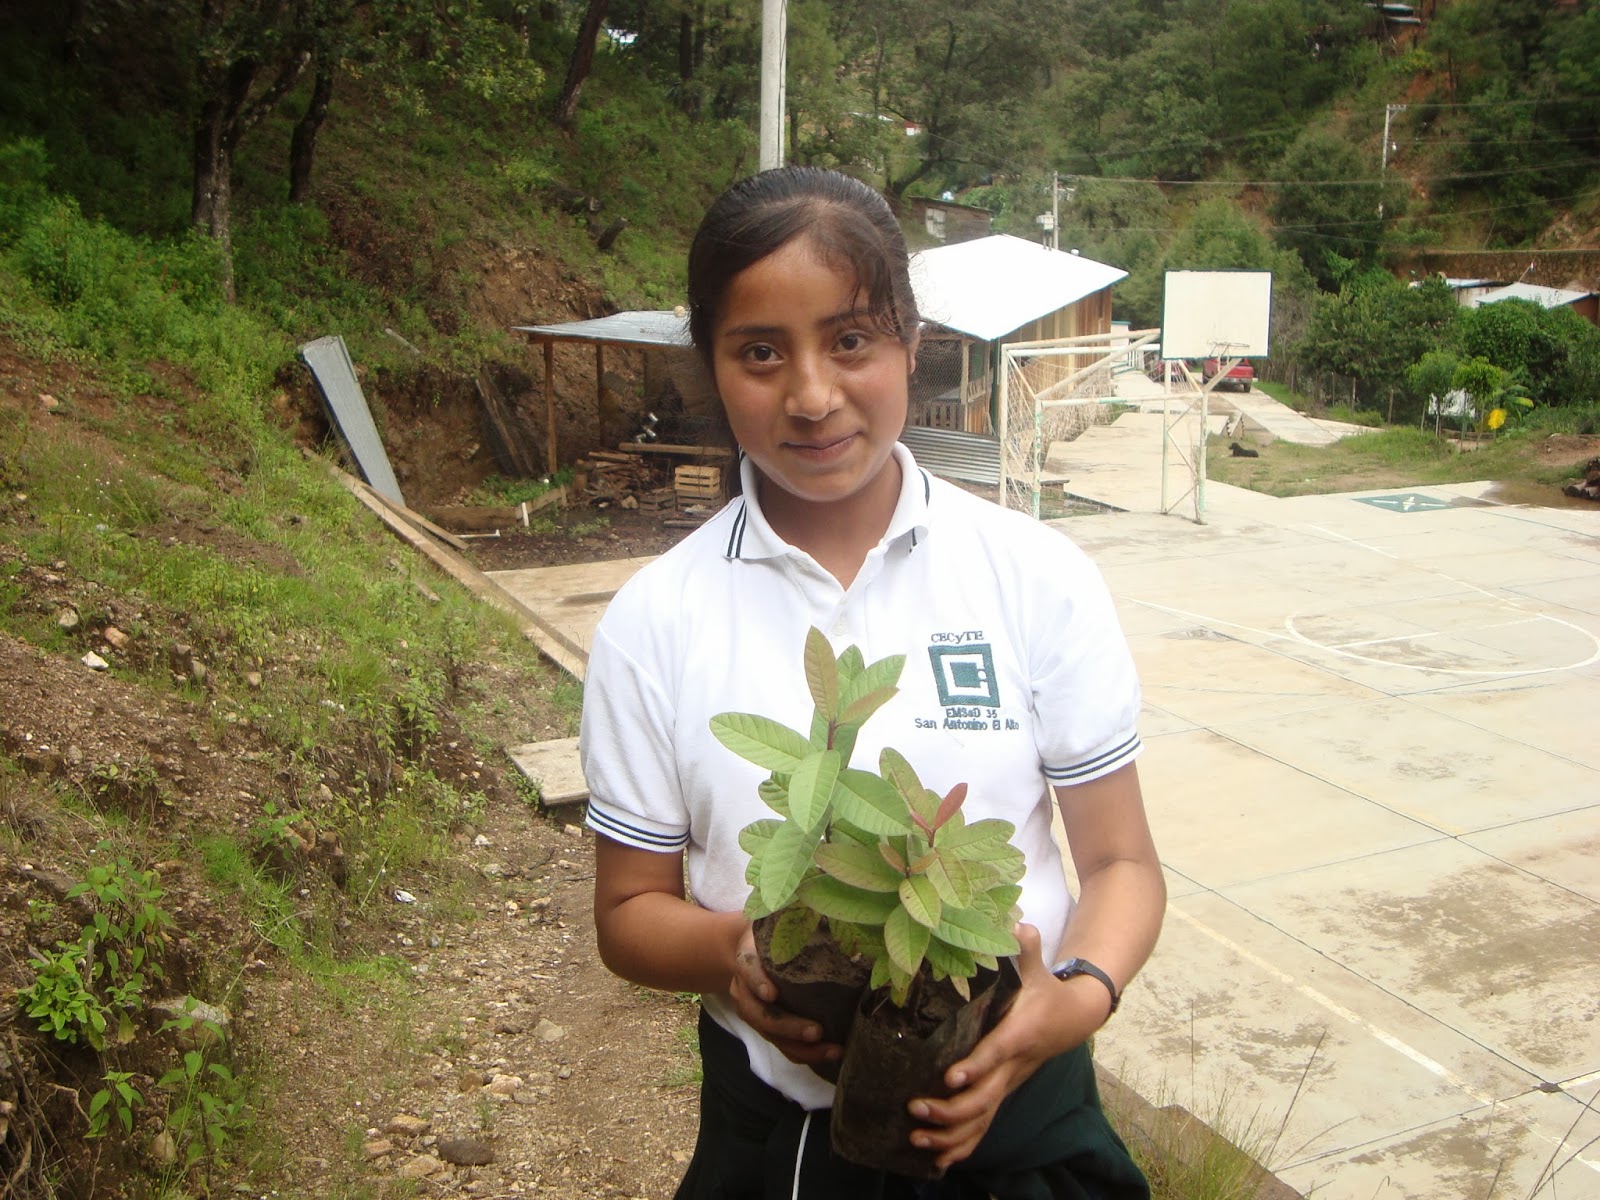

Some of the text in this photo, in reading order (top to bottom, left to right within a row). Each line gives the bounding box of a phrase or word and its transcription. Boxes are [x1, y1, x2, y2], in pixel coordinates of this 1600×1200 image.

[931, 631, 984, 644] CECyTE
[986, 709, 997, 718] 35
[915, 717, 1019, 730] San Antonino El Alto
